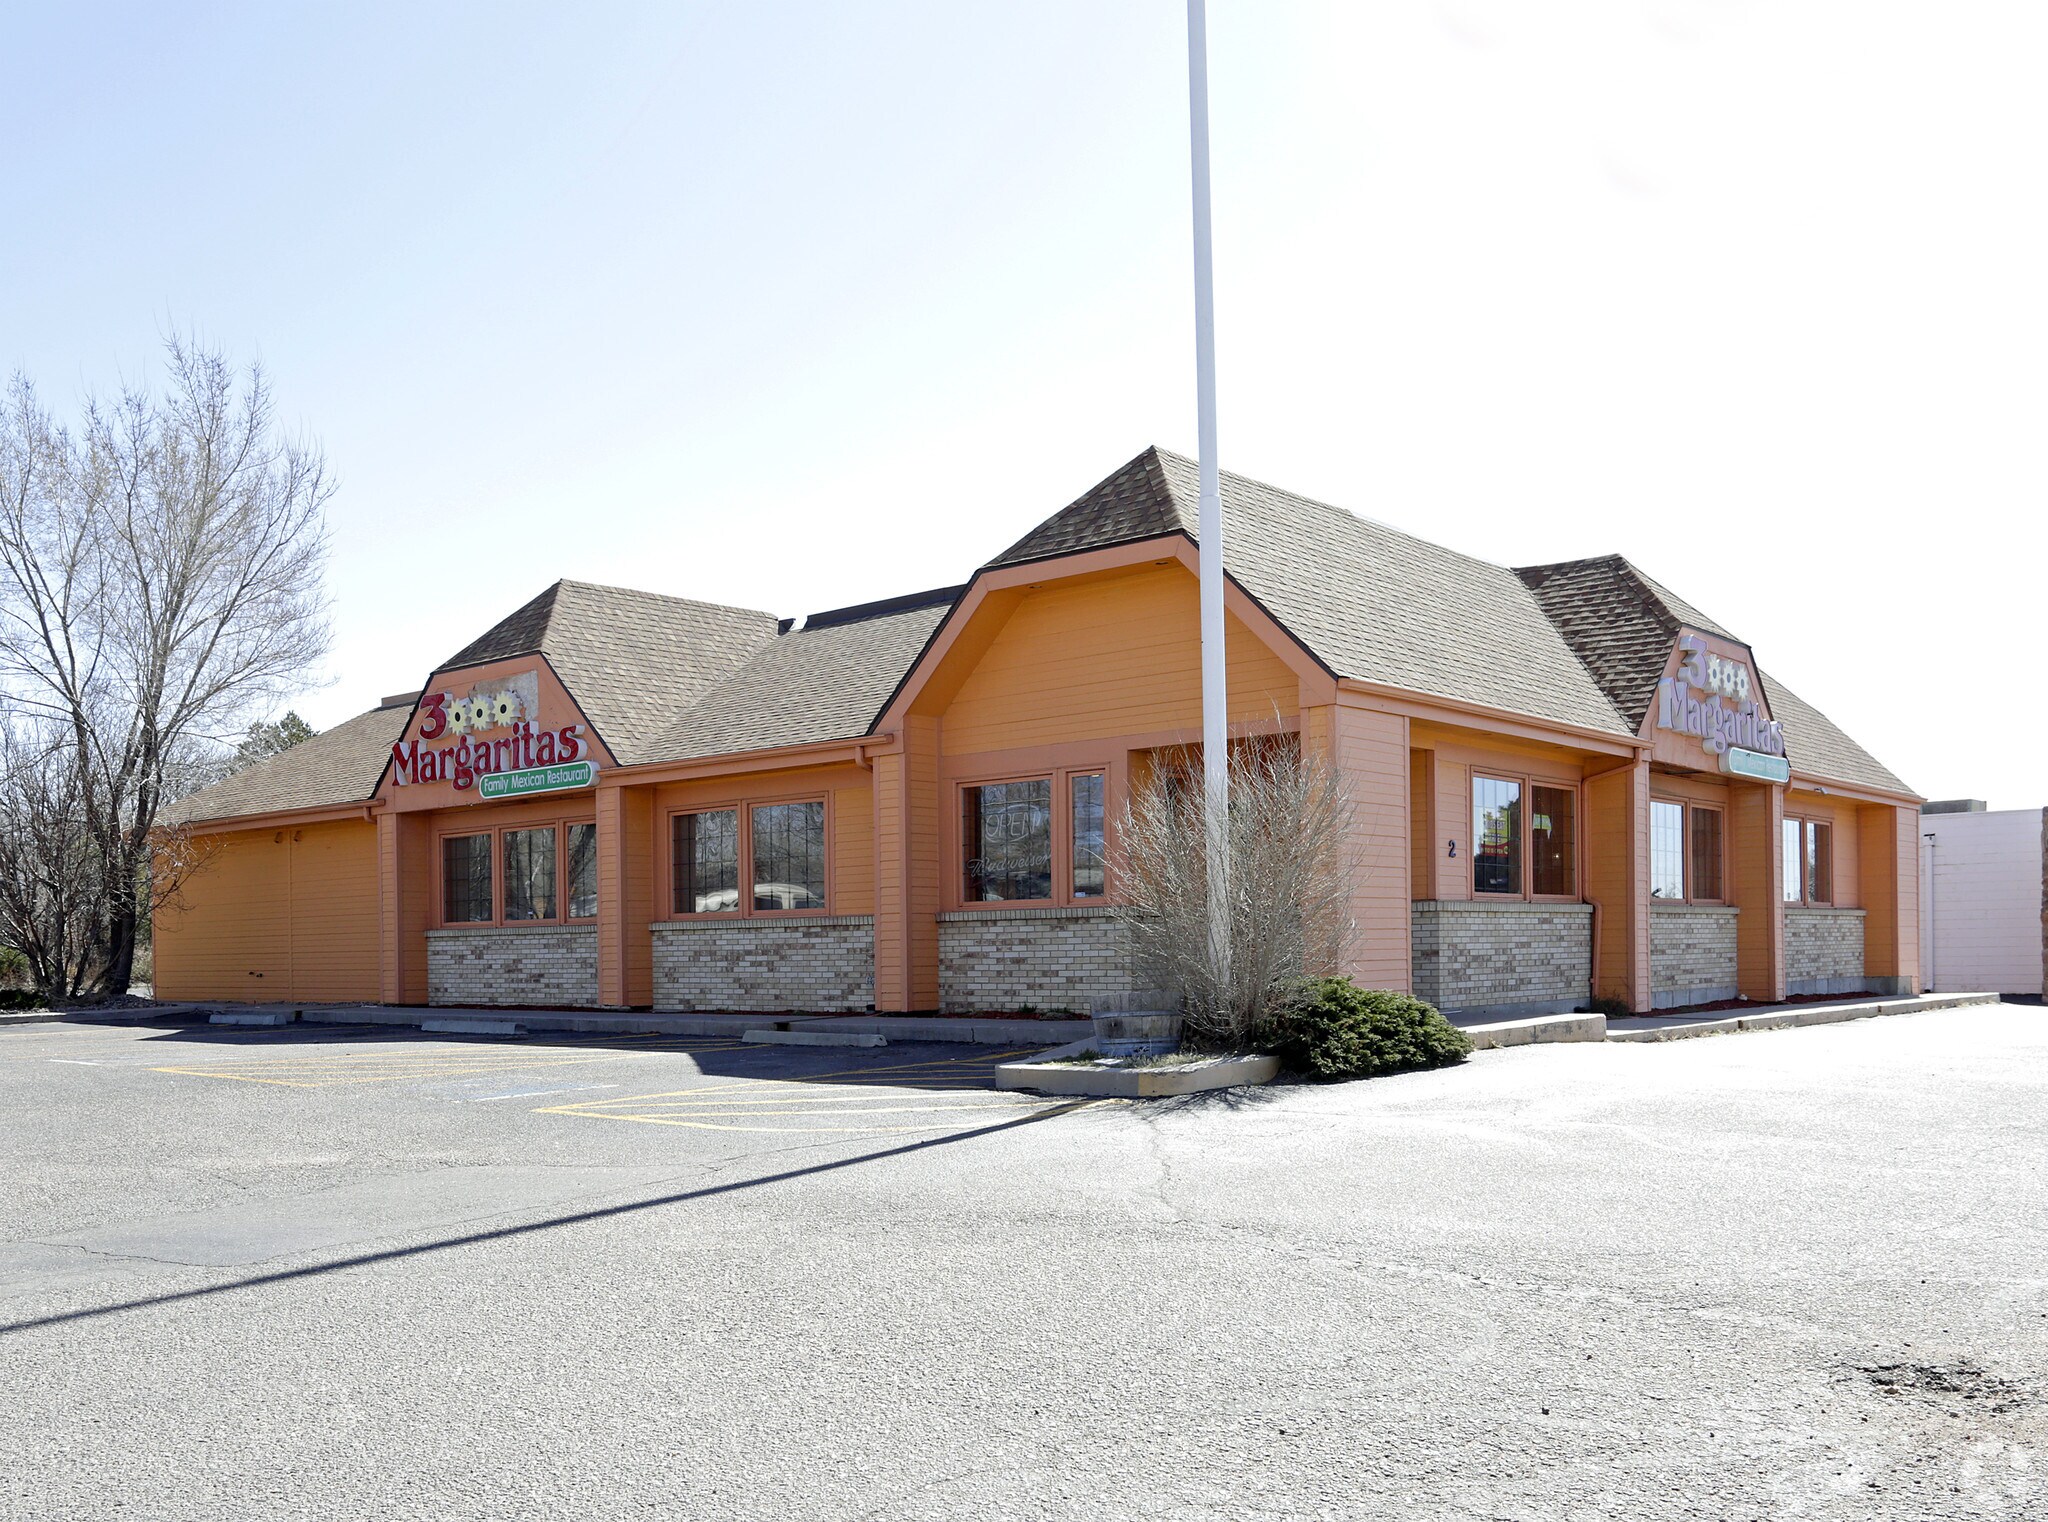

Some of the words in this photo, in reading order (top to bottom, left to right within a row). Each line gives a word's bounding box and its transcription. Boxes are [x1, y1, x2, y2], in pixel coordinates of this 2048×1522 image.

[1678, 635, 1707, 689] 3
[418, 692, 449, 740] 3
[1658, 677, 1785, 755] Margaritas
[392, 720, 583, 791] Margaritas
[484, 777, 509, 793] Family
[511, 773, 545, 789] Mexican
[547, 765, 589, 784] Restaurant
[985, 812, 1037, 837] OPEN
[967, 854, 1051, 877] Budweiser
[1448, 839, 1456, 858] 2
